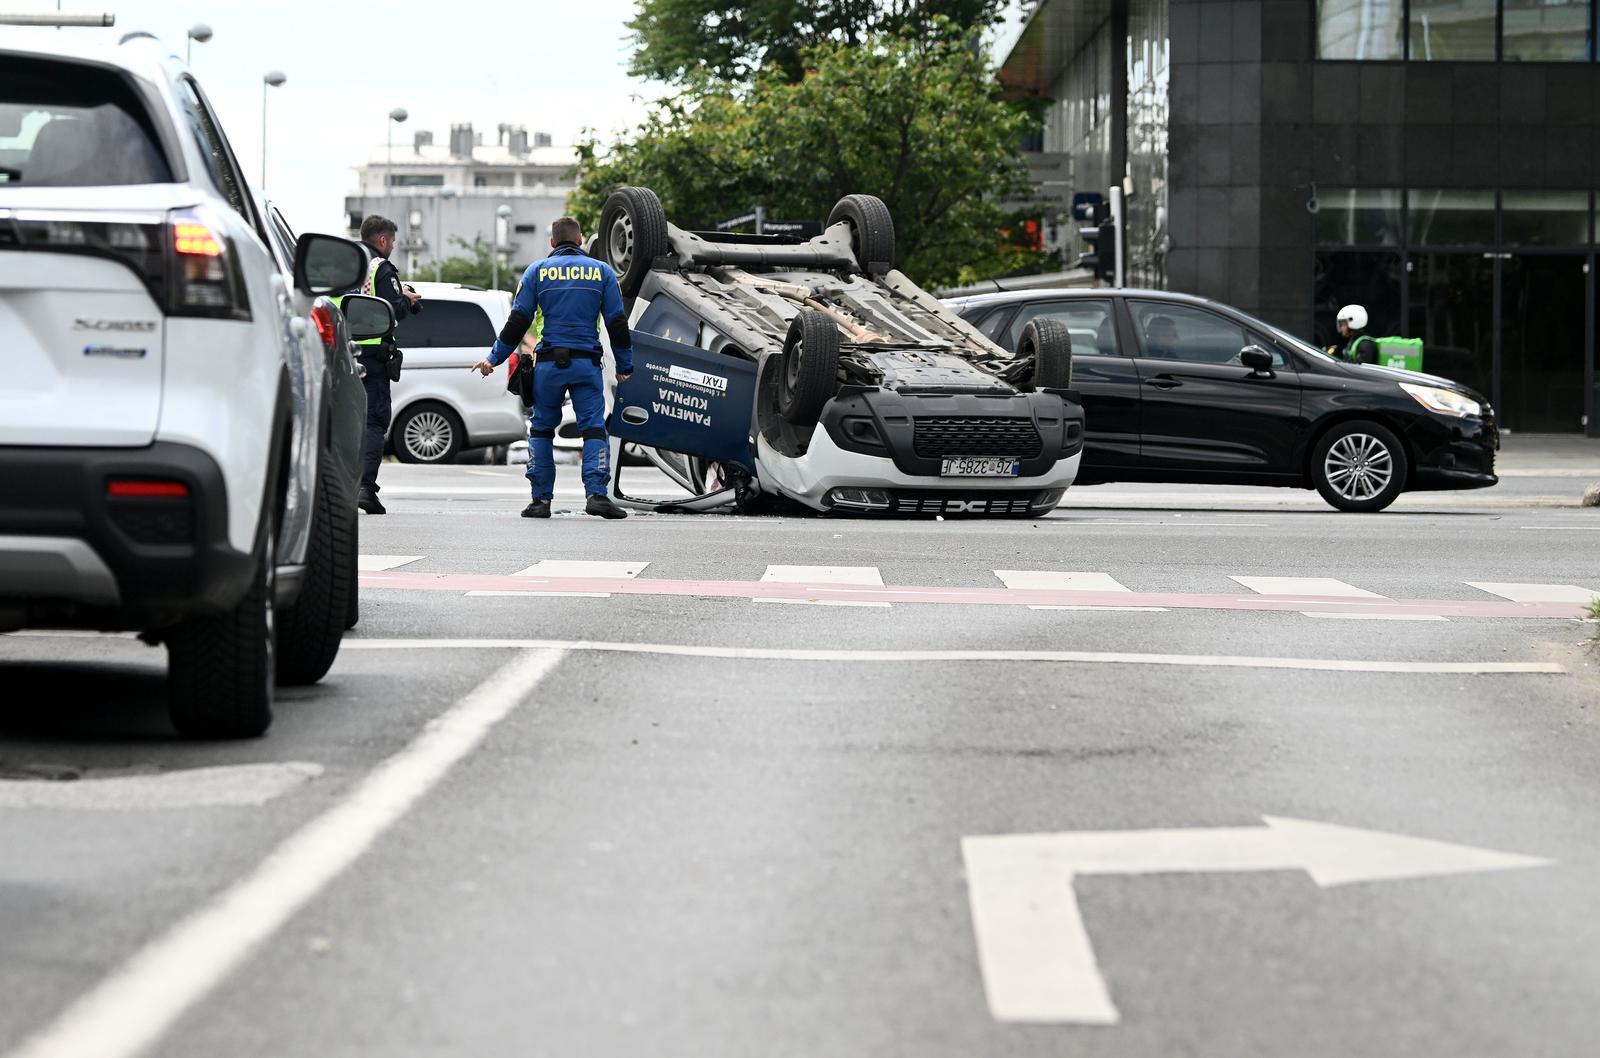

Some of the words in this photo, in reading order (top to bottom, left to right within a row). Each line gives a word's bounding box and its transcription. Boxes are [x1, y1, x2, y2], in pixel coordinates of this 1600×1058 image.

[539, 266, 602, 282] POLICIJA
[659, 375, 676, 384] zavoj
[702, 375, 723, 388] TAXI
[658, 388, 707, 410] KUPNJA
[652, 401, 711, 426] PAMETNA
[996, 461, 1012, 474] ZG
